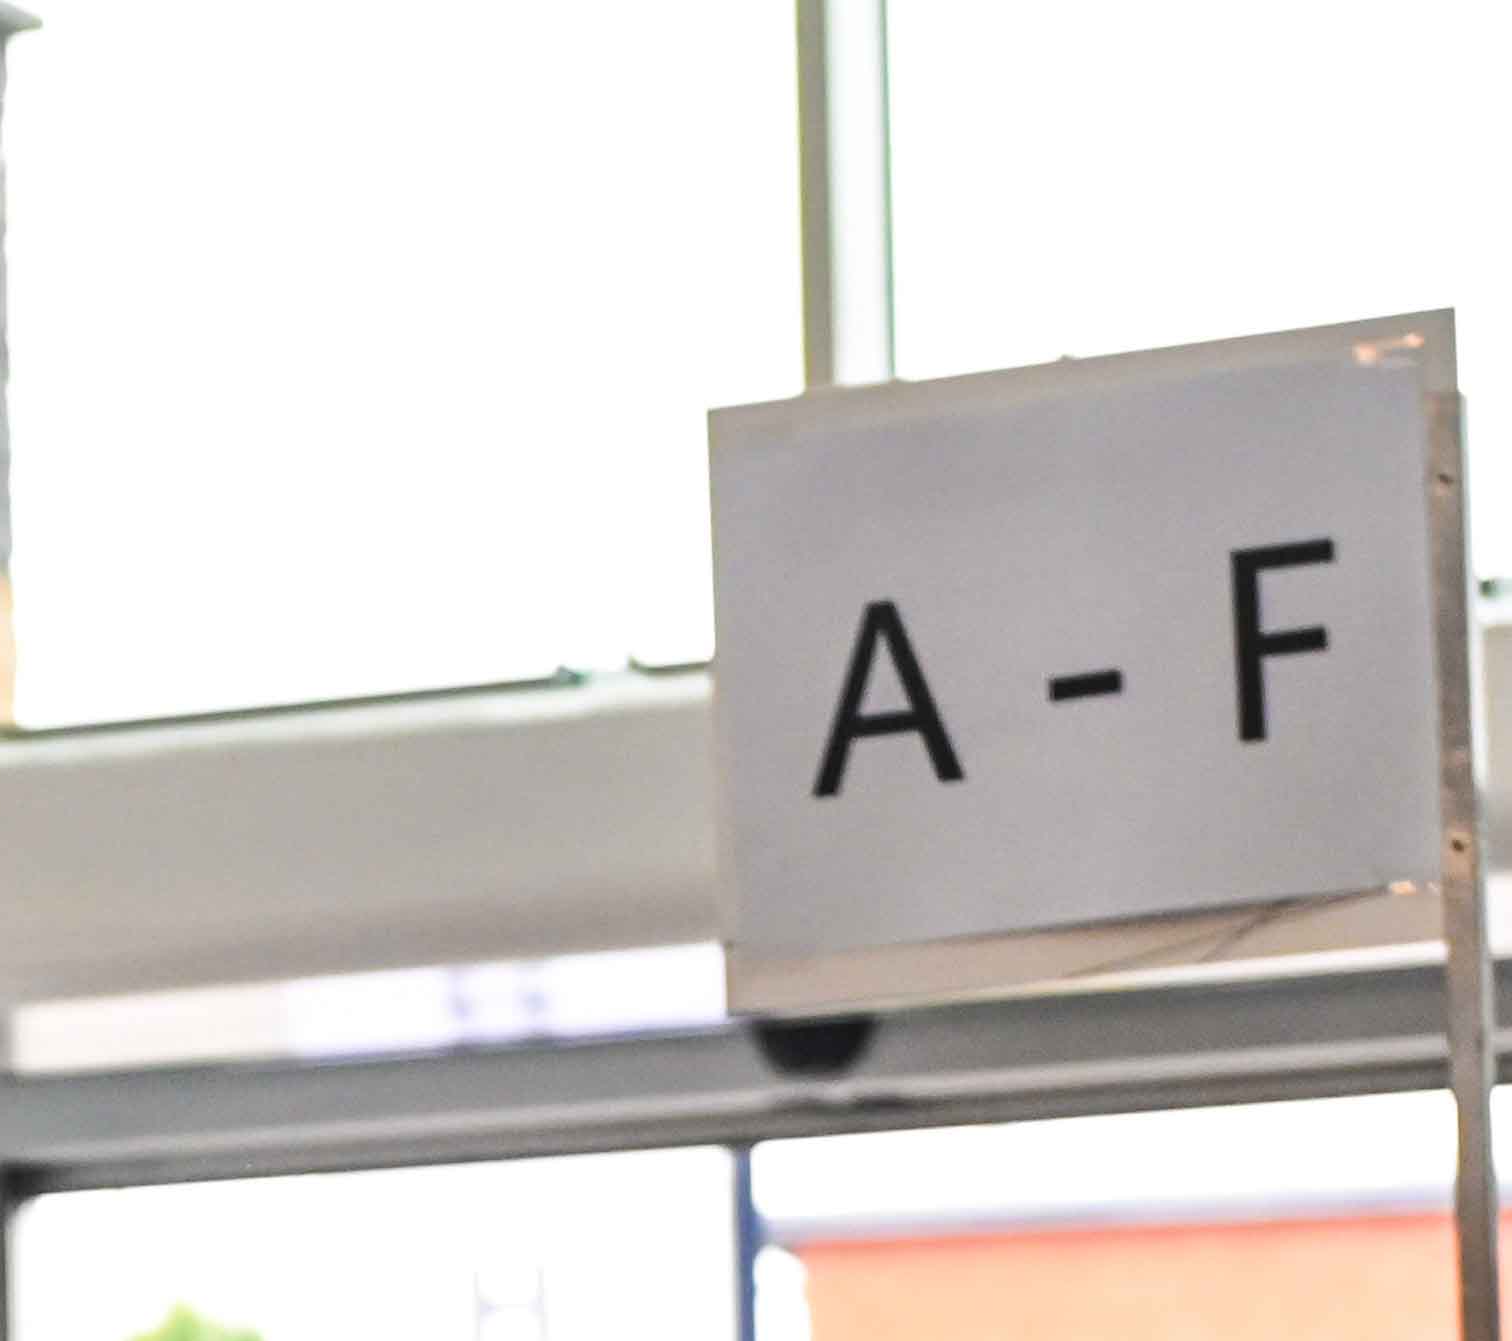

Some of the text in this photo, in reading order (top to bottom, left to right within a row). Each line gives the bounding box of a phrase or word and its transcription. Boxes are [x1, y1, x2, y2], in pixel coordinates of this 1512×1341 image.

[813, 537, 1337, 798] A - F
